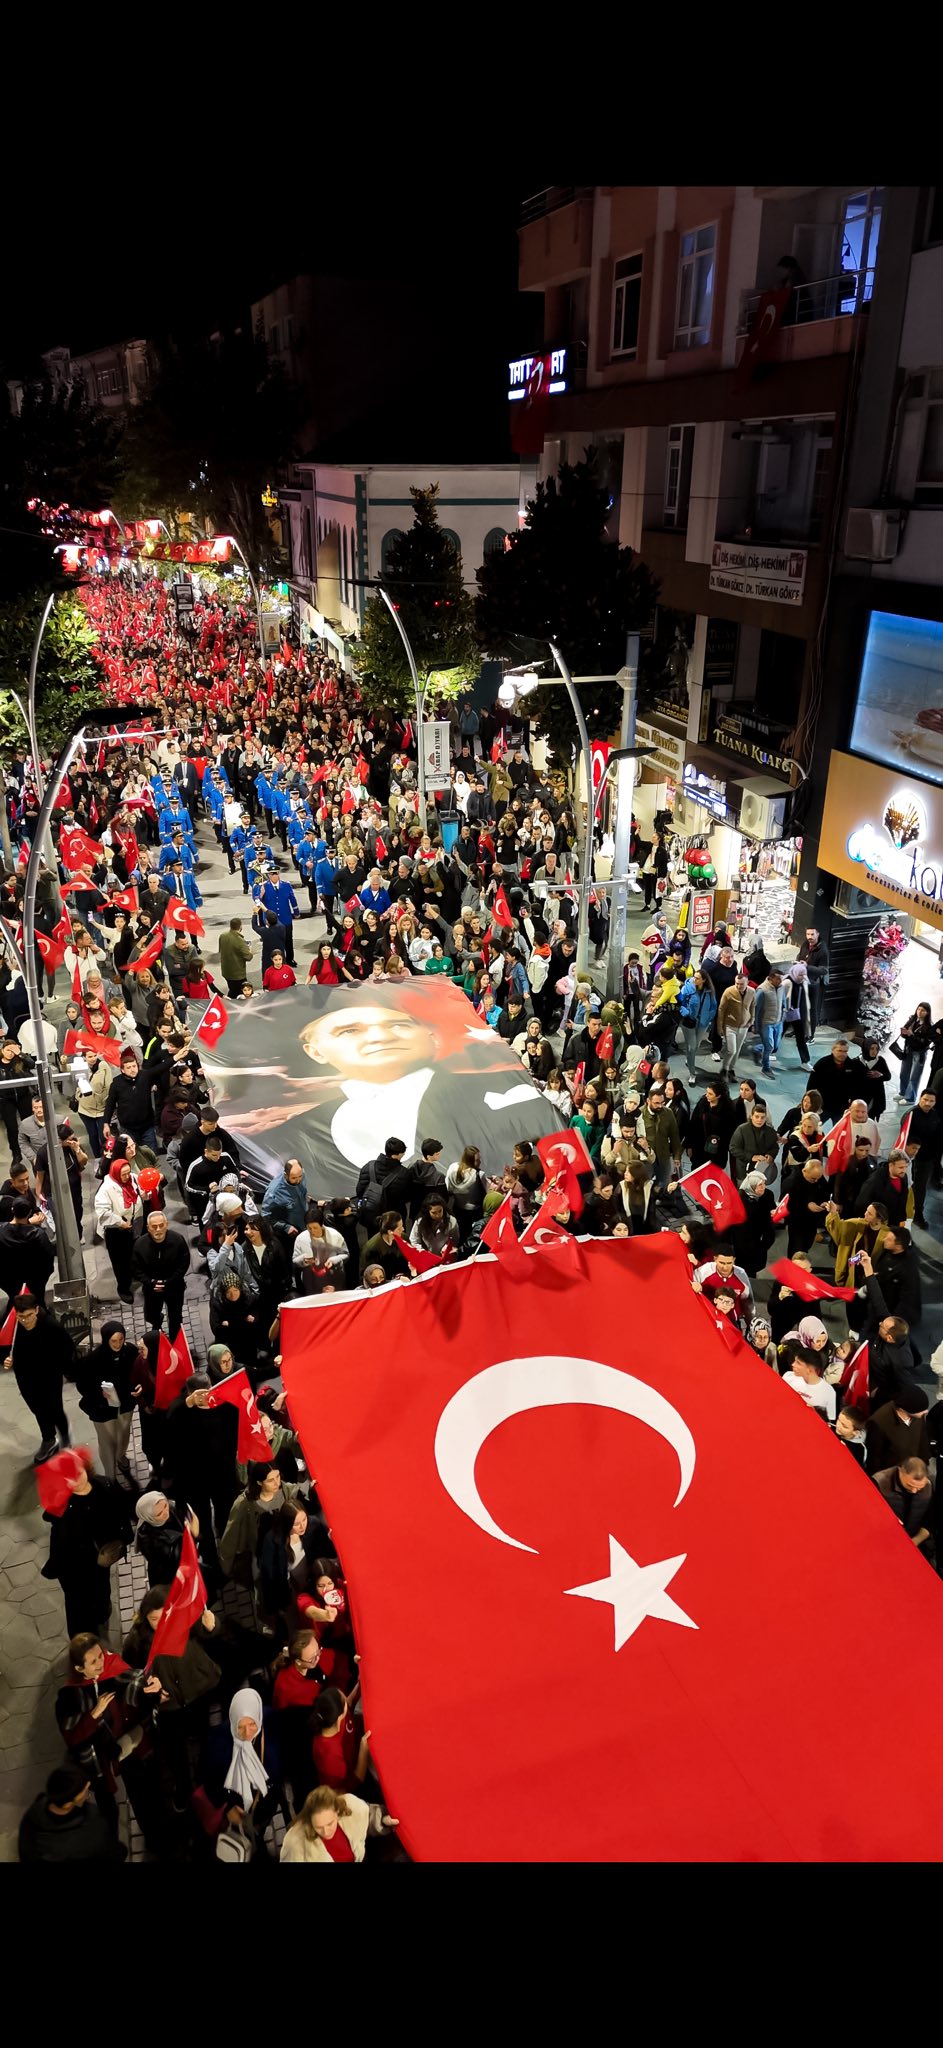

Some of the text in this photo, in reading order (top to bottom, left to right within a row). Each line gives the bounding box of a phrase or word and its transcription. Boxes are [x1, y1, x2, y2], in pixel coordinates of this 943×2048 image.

[748, 553, 788, 572] DİŞ HEKİMİ
[755, 582, 779, 598] TÜRKAN
[713, 728, 749, 756] TUANA
[866, 871, 911, 900] accessories
[913, 893, 921, 904] &
